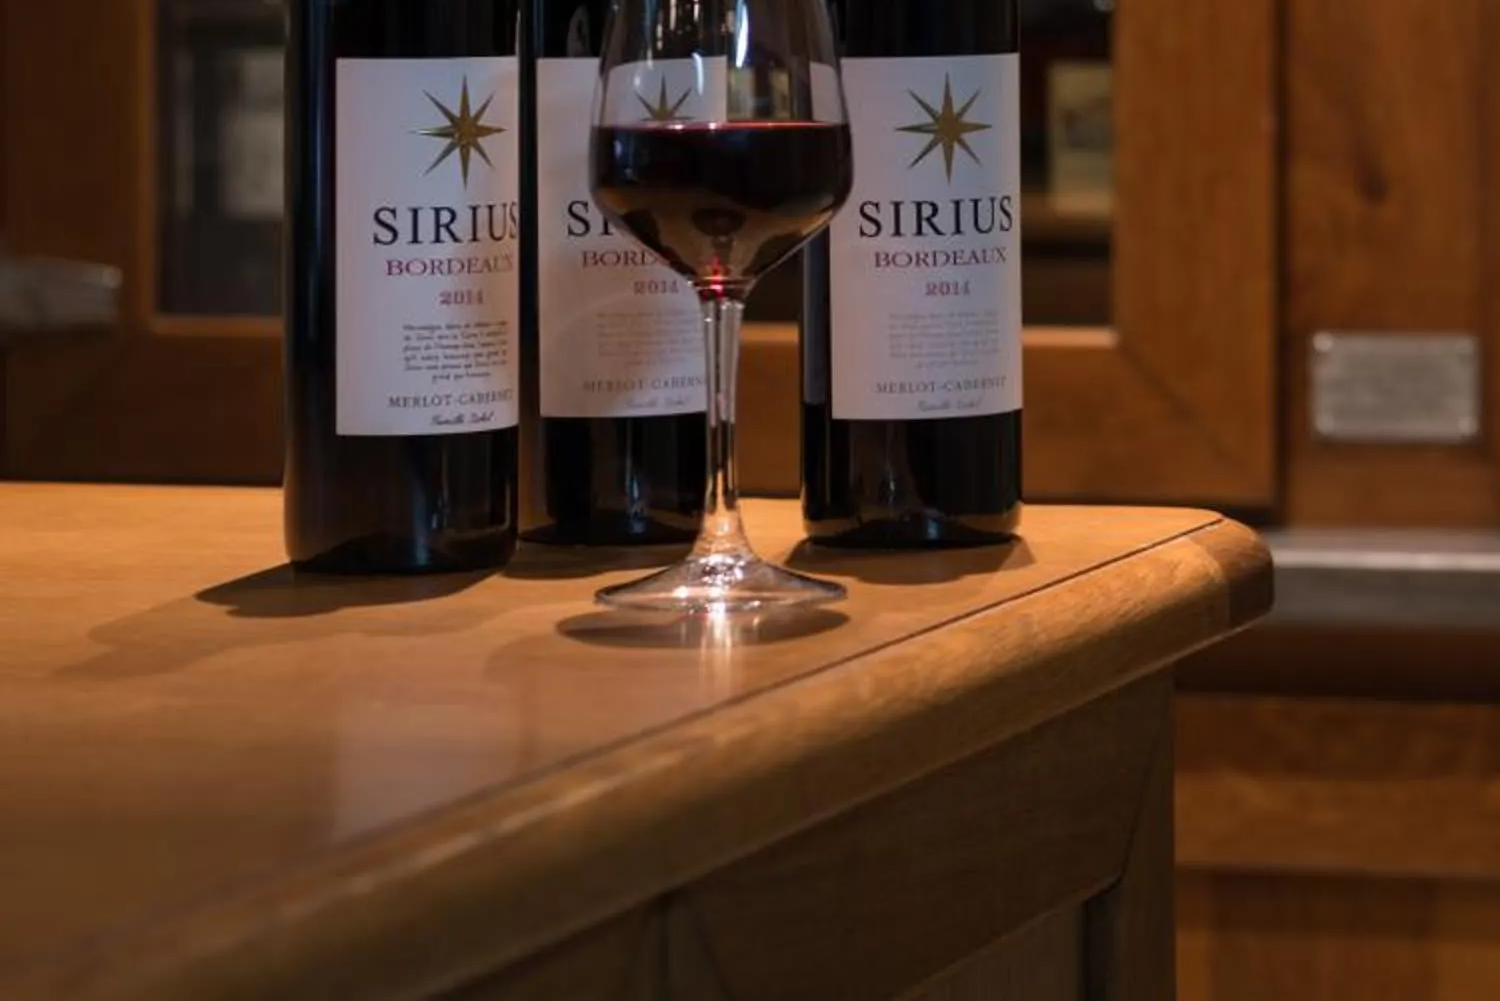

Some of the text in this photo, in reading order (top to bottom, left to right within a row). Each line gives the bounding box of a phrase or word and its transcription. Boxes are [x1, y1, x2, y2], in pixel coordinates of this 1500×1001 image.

[373, 201, 517, 245] SIRIUS
[859, 196, 1013, 238] SIRIUS
[875, 247, 1007, 268] BORDEAUX
[634, 279, 680, 294] 2014
[925, 281, 970, 296] 2014
[438, 288, 484, 305] 2014
